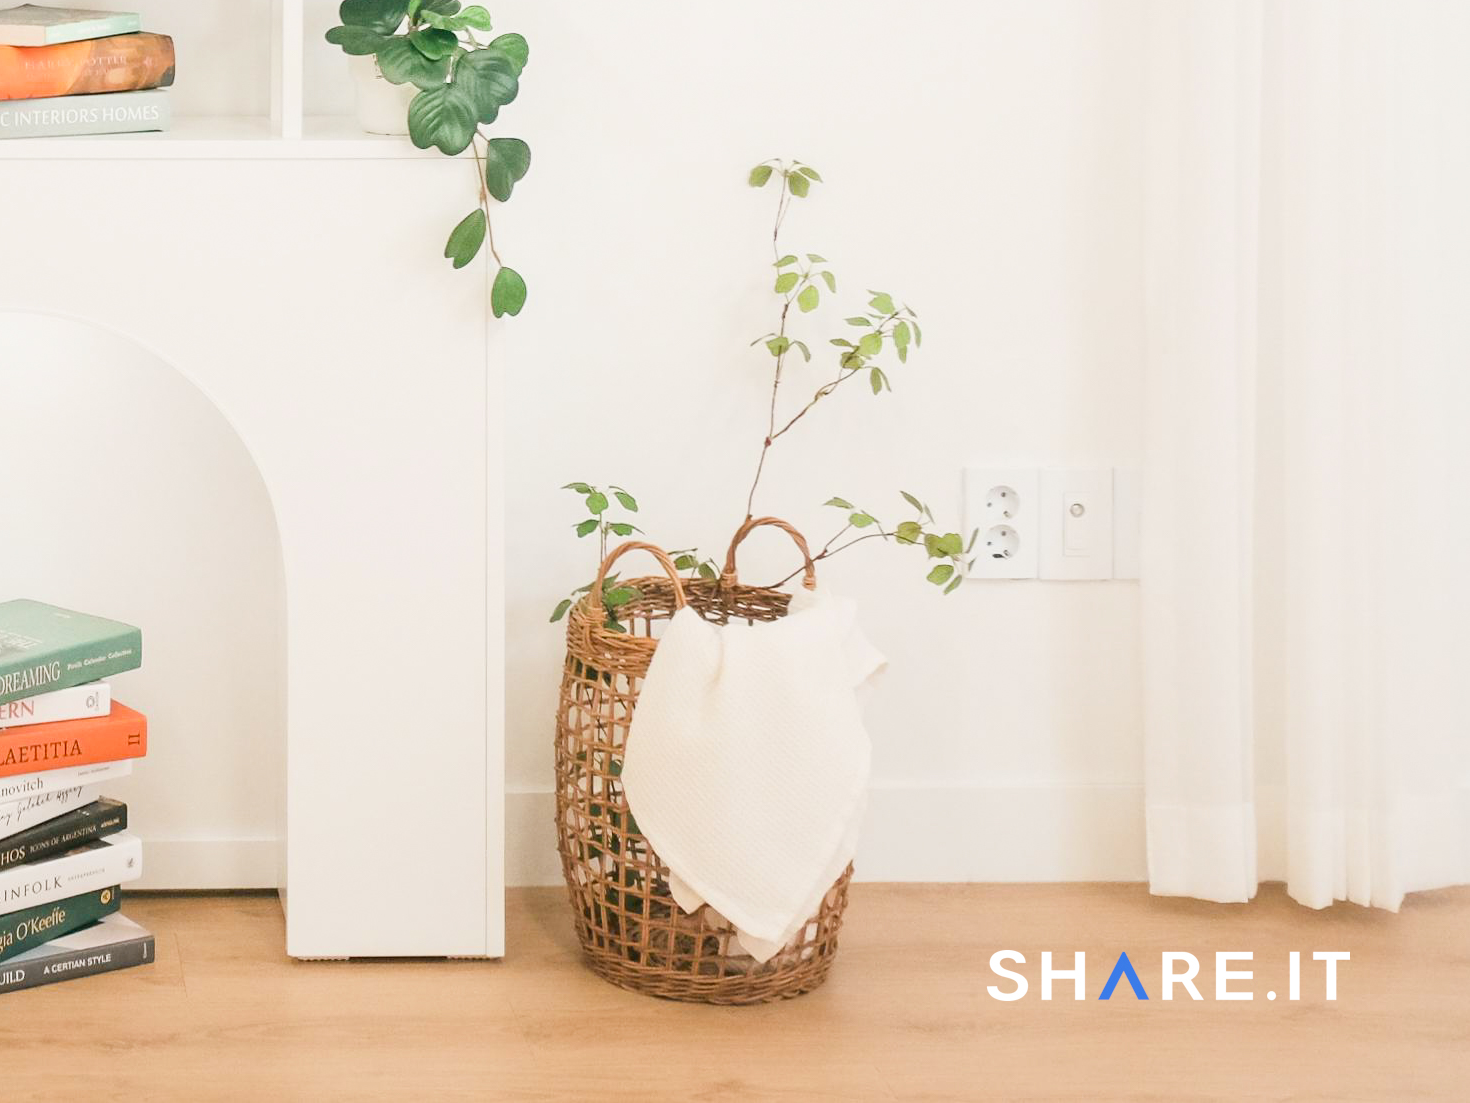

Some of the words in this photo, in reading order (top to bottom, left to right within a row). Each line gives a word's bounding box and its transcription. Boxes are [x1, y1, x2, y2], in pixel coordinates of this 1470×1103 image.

[14, 108, 98, 127] INTERIORS
[101, 105, 160, 122] HOMES
[28, 841, 51, 854] ICONS
[50, 836, 60, 848] OF
[60, 824, 98, 843] ARGENTINA
[16, 906, 67, 940] O'Keeffe
[43, 966, 51, 975] A
[87, 952, 113, 967] STYLE
